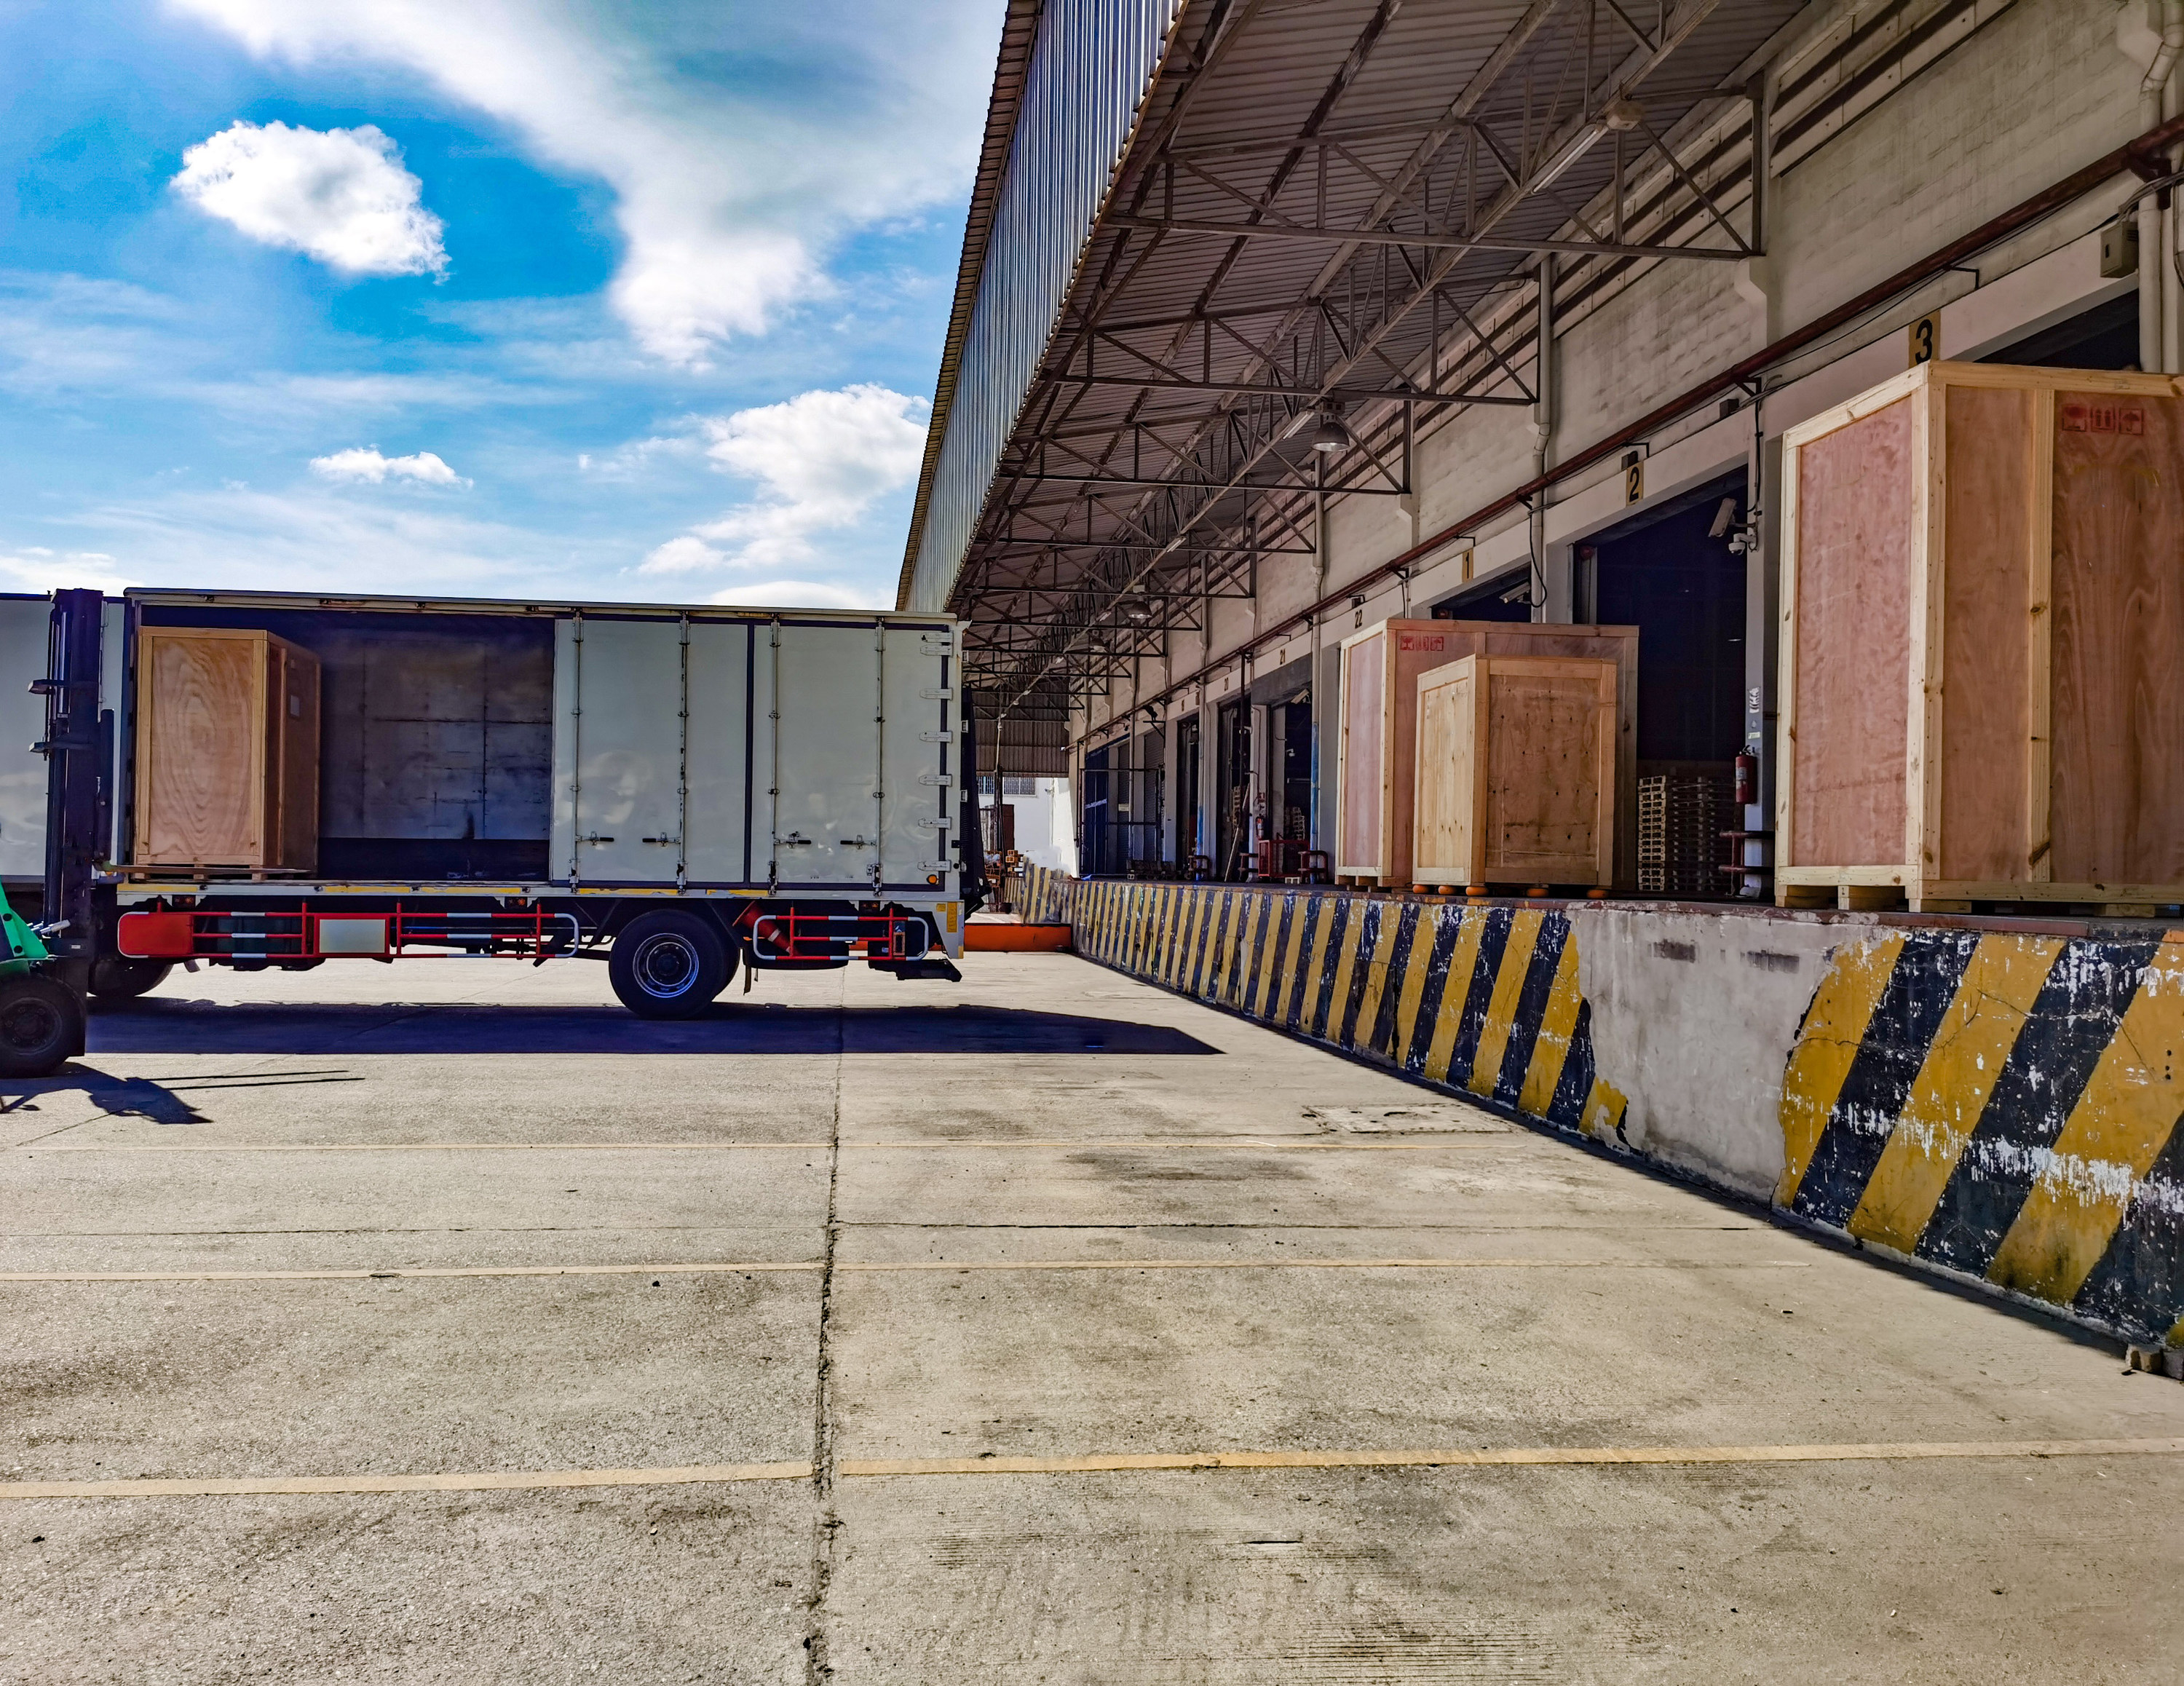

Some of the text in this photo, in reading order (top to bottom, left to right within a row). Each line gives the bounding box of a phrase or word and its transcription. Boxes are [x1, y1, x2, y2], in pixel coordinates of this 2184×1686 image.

[1915, 319, 1932, 364] 3
[1629, 467, 1639, 502] 2
[1465, 552, 1469, 579] 1
[1355, 609, 1363, 629] 22
[1279, 648, 1286, 665] 21
